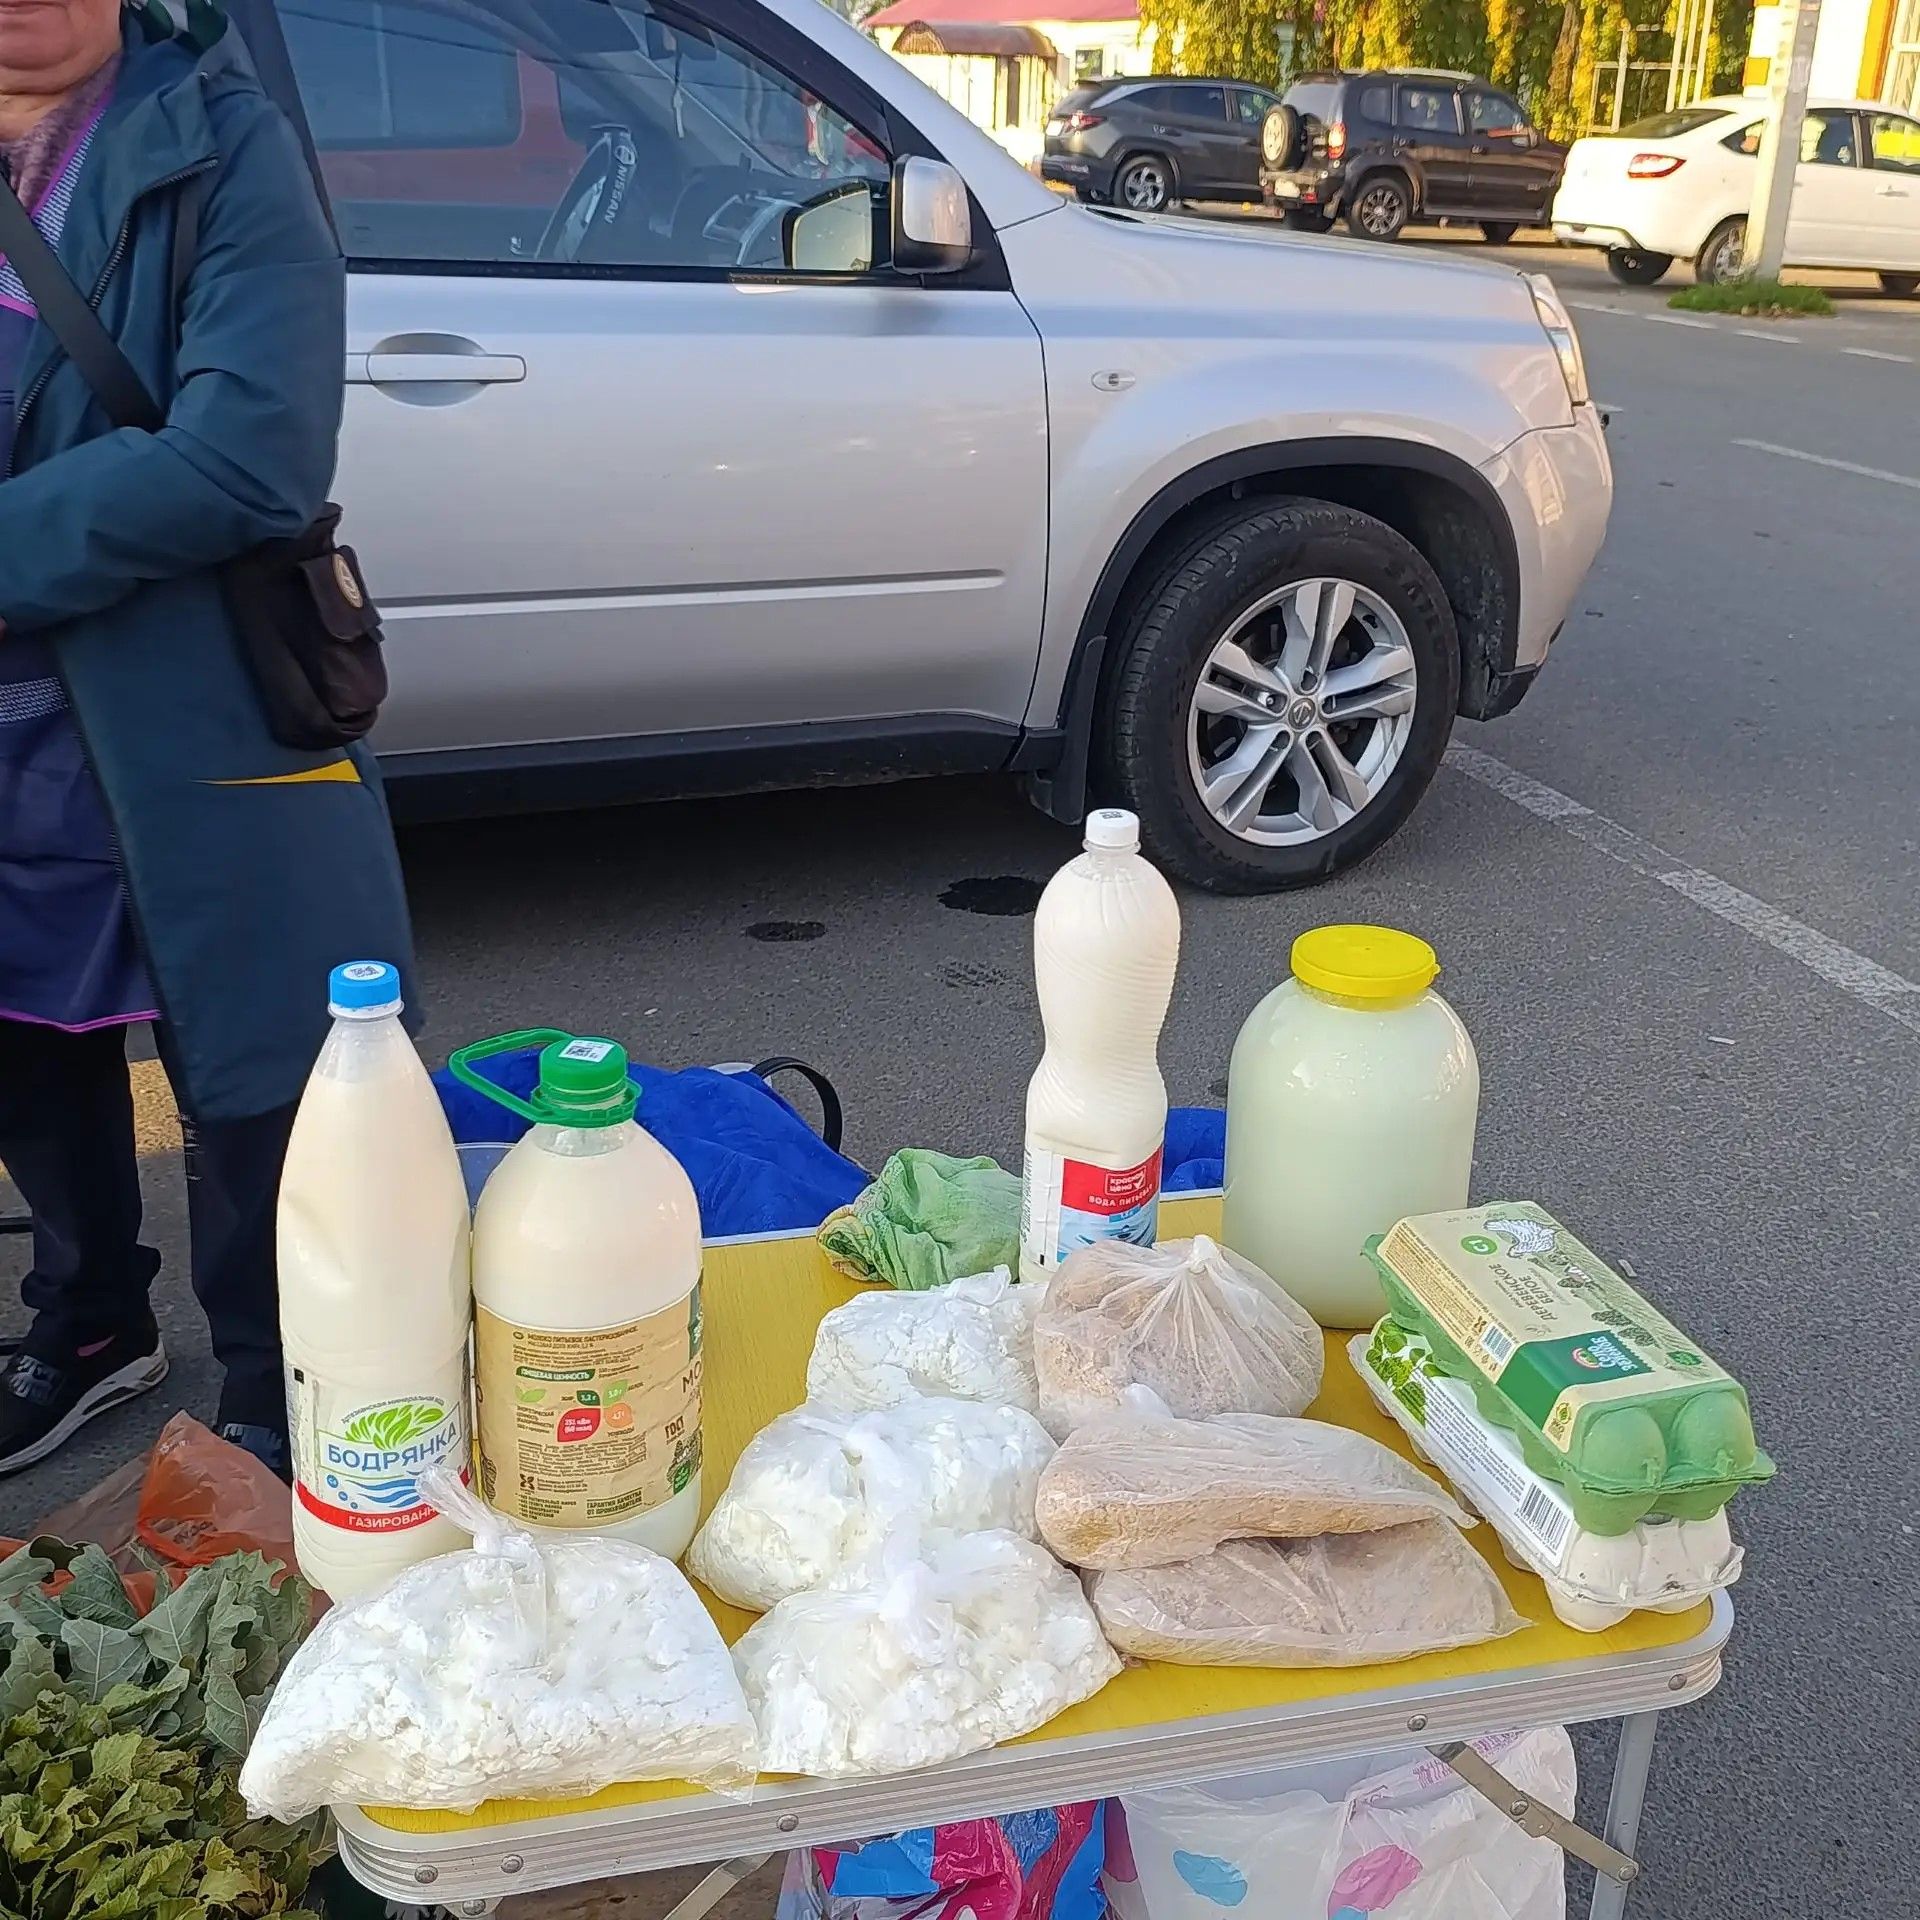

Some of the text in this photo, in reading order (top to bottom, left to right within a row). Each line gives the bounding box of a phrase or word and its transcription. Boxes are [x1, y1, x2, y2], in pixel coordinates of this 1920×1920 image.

[604, 164, 628, 224] NISSAN
[1088, 1195, 1116, 1207] ВОДА
[1488, 1263, 1558, 1321] ДЕРЕВЕНСКОЕ
[1518, 1275, 1554, 1304] БЕЛОЕ
[664, 1415, 685, 1439] ГОСТ
[328, 1421, 457, 1472] БОДРЯНКА
[348, 1506, 437, 1528] ГАЗИРОВАНН
